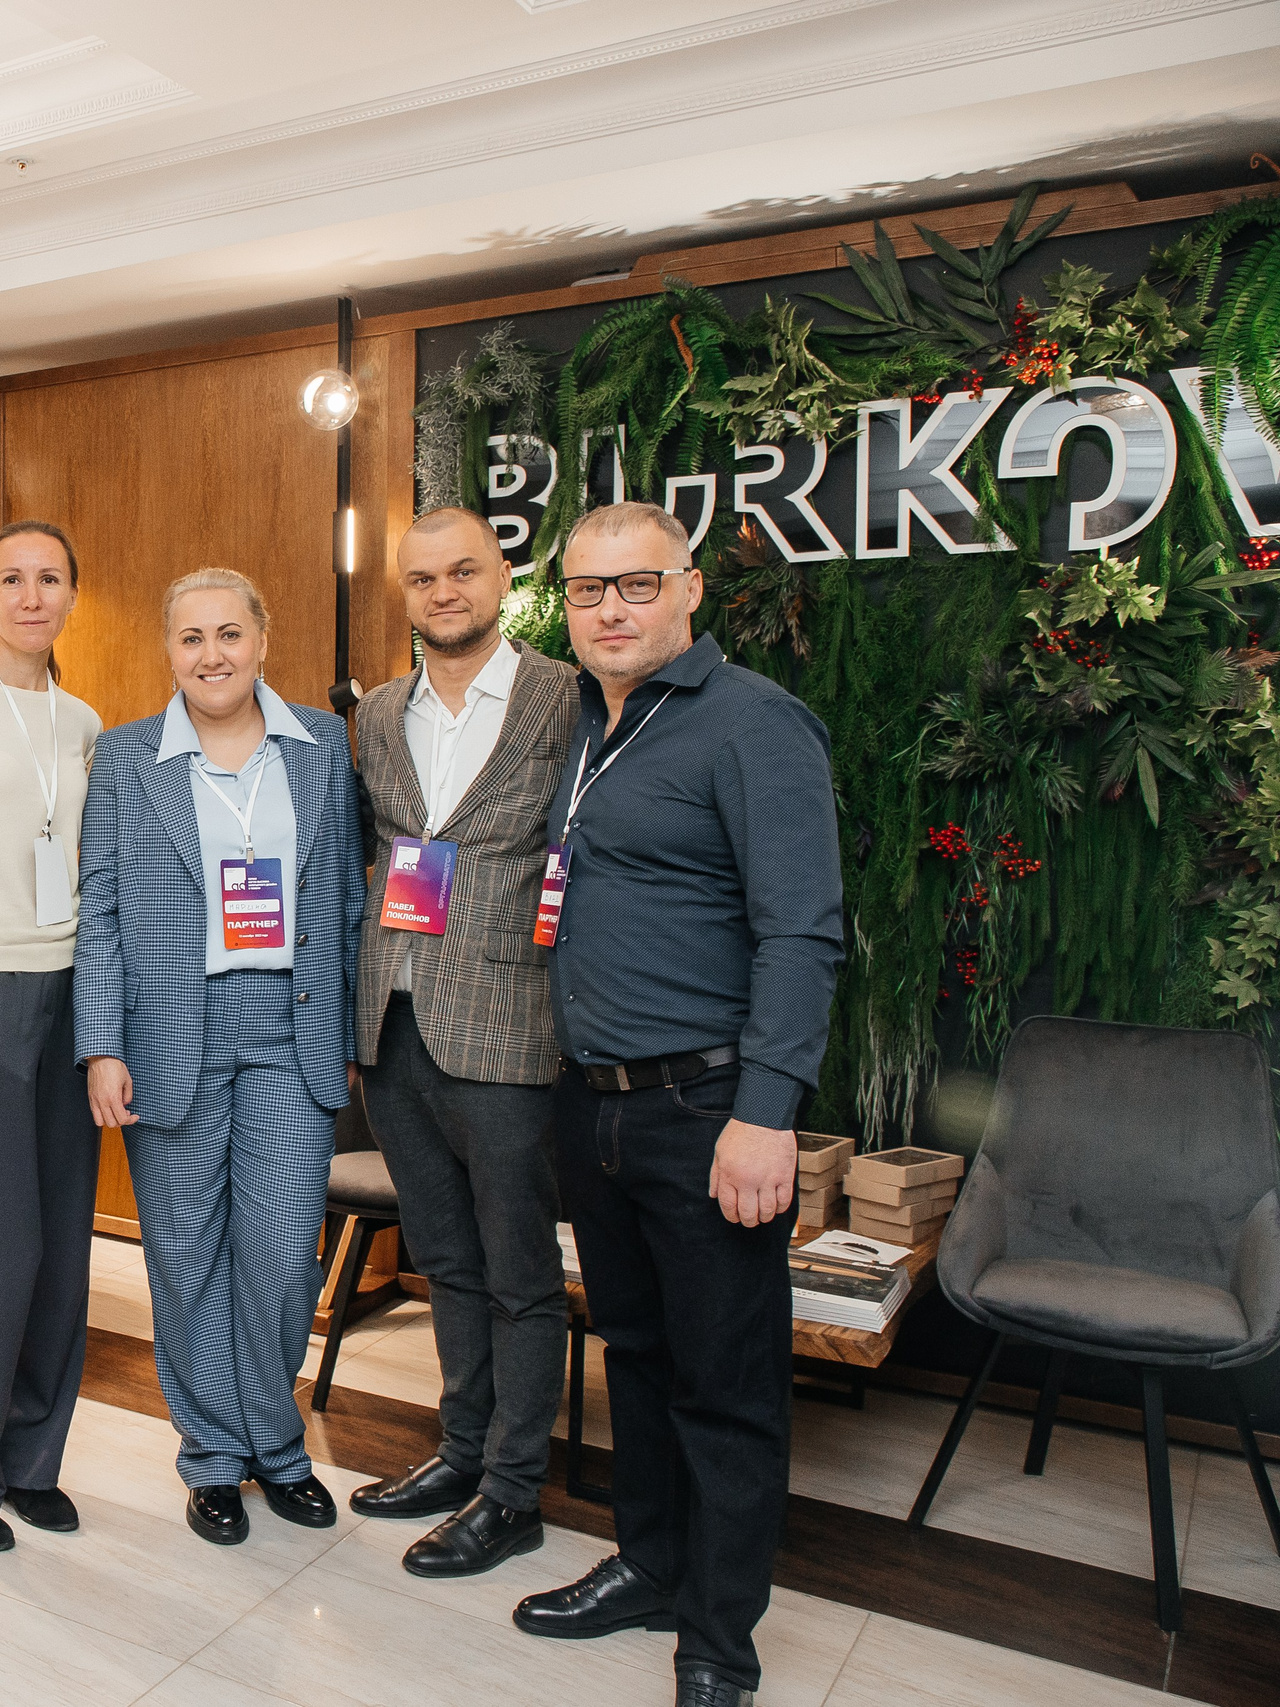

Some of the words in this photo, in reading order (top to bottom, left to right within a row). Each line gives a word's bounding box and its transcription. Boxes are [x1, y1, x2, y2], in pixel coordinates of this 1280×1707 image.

[387, 901, 415, 912] ПАВЕЛ
[386, 910, 430, 924] ПОКЛОНОВ
[227, 920, 279, 930] ПАРТНЕР
